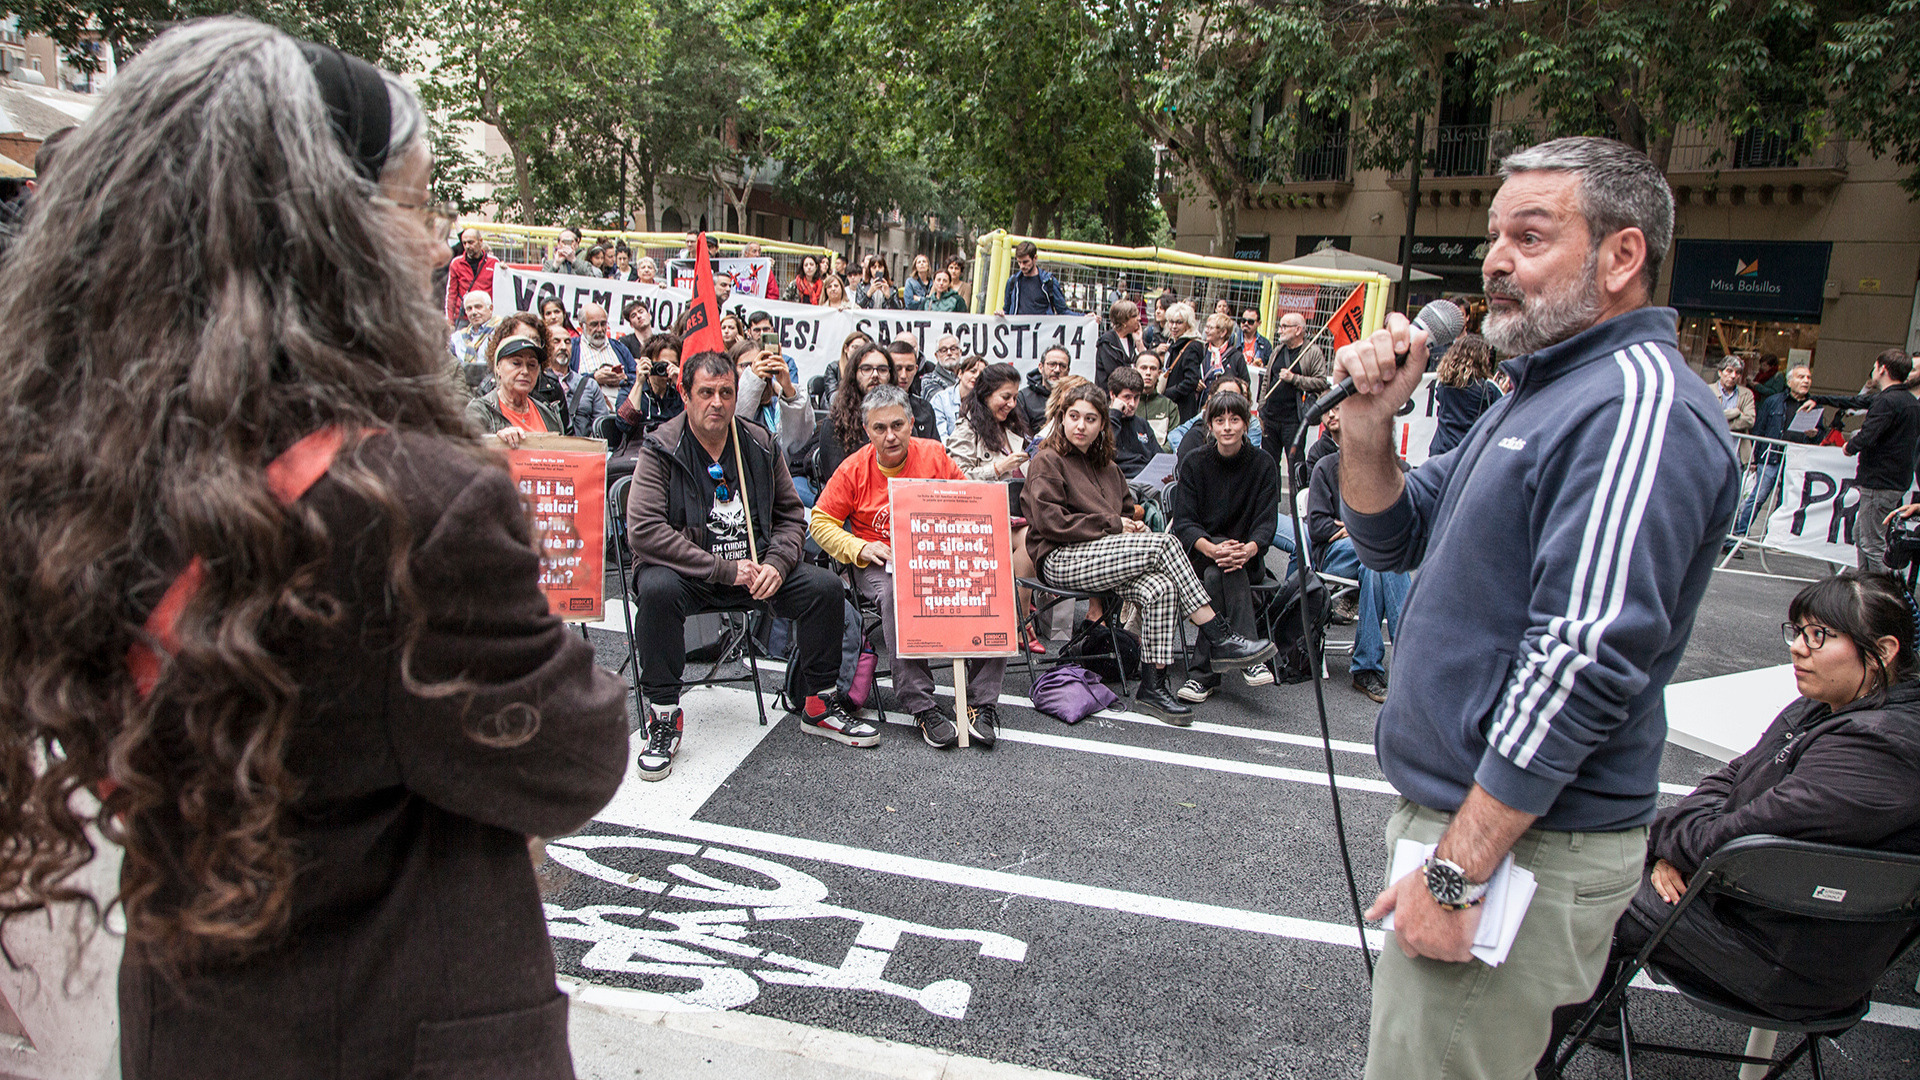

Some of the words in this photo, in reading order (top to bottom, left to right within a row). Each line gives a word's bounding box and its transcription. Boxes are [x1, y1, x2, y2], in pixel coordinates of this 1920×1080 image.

[1412, 242, 1434, 254] Bar
[1710, 279, 1734, 291] Miss
[1738, 280, 1780, 293] Bolsillos
[520, 480, 532, 494] Si
[536, 480, 551, 495] hi
[555, 481, 574, 496] ha
[536, 499, 578, 513] salari
[535, 516, 570, 533] ínim,
[911, 519, 930, 533] No
[934, 523, 993, 534] marxem
[543, 535, 562, 549] uè
[566, 538, 584, 549] no
[712, 544, 723, 552] EM
[723, 540, 747, 551] CUIDEN
[917, 540, 935, 551] en
[940, 537, 988, 554] silenci,
[540, 556, 581, 570] oguer
[908, 555, 950, 569] alcem
[954, 555, 968, 569] la
[972, 559, 998, 570] veu
[538, 570, 573, 584] xim?
[937, 573, 943, 587] i
[947, 577, 972, 588] ens
[924, 591, 987, 610] quedem!
